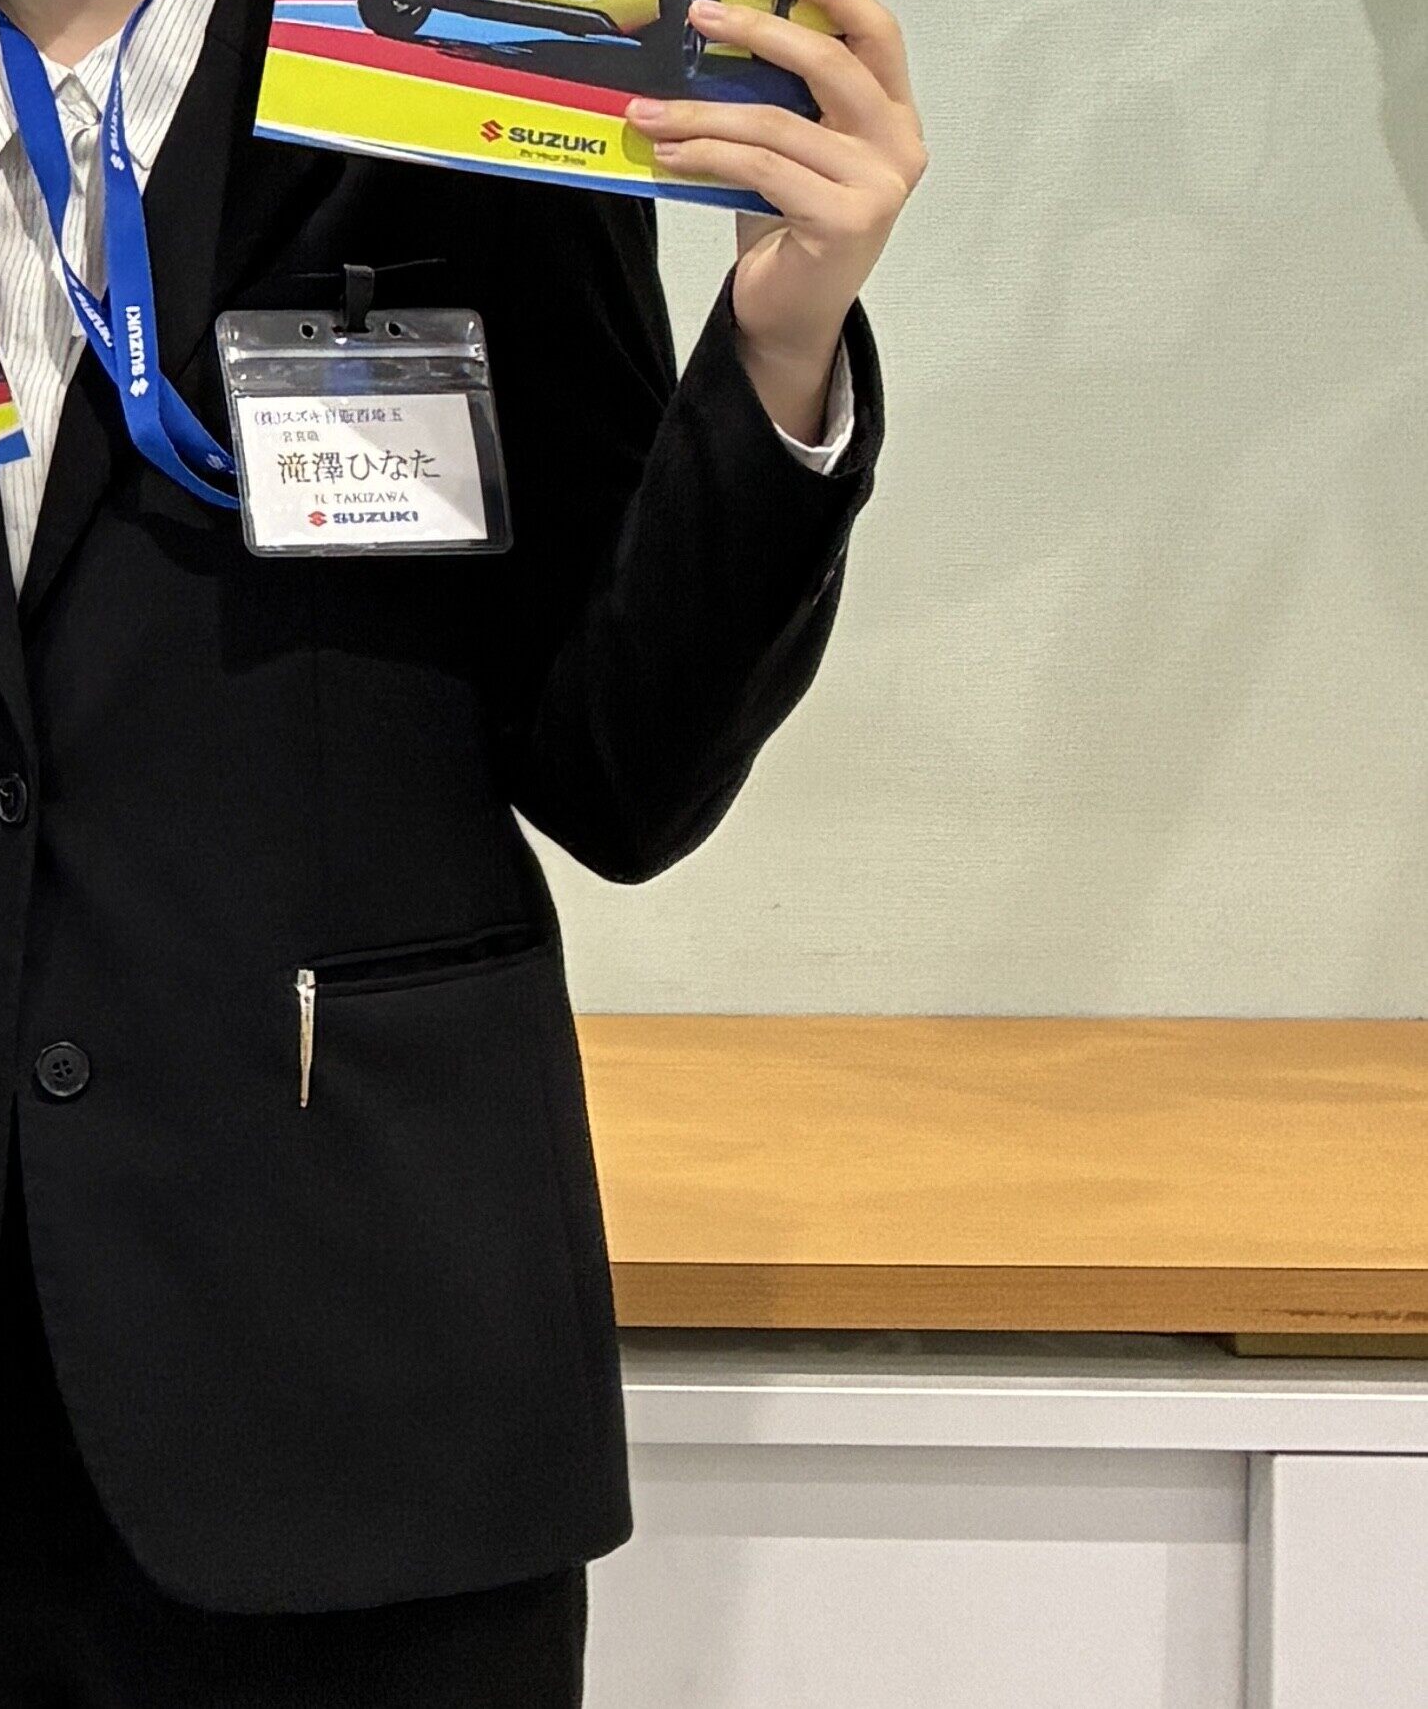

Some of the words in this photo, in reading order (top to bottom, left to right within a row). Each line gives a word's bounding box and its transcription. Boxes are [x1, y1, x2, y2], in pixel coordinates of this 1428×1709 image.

[508, 127, 607, 156] SUZUKI
[126, 305, 145, 377] SUZUKI
[278, 449, 442, 485] 滝澤ひなた
[333, 510, 419, 524] SUZUKI
